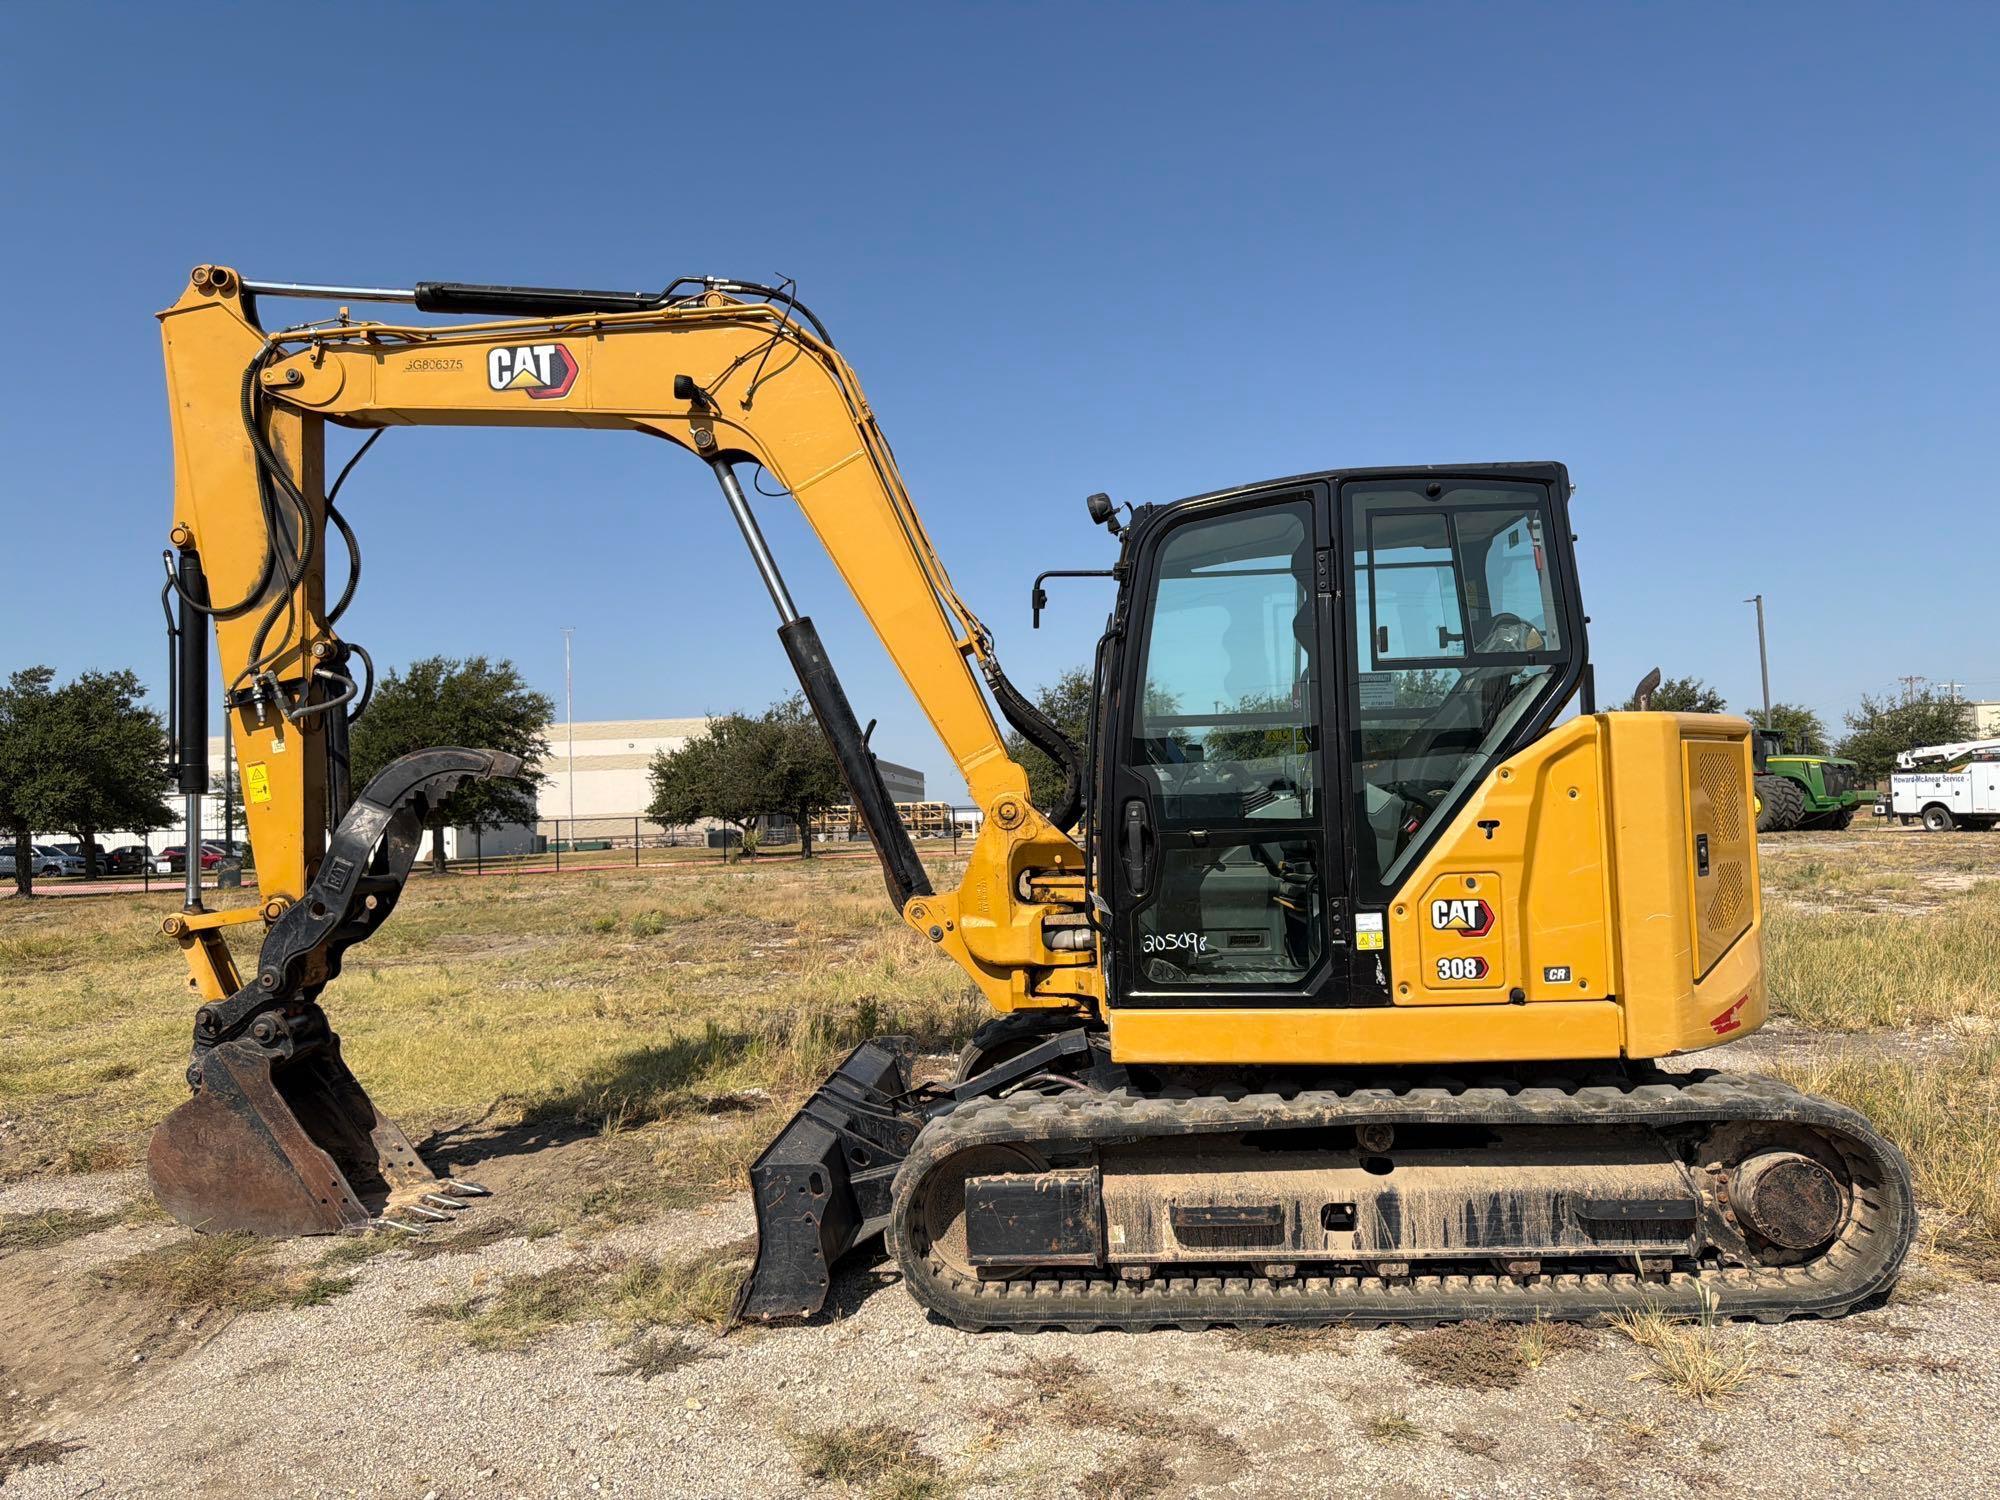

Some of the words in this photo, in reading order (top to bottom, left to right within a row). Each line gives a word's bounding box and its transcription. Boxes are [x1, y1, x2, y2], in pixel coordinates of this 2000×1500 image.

[489, 344, 555, 390] CAT
[1942, 774, 1965, 783] Service
[1432, 900, 1479, 929] CAT
[1142, 932, 1207, 954] 205098
[1438, 957, 1477, 979] 308
[1548, 969, 1566, 981] CR
